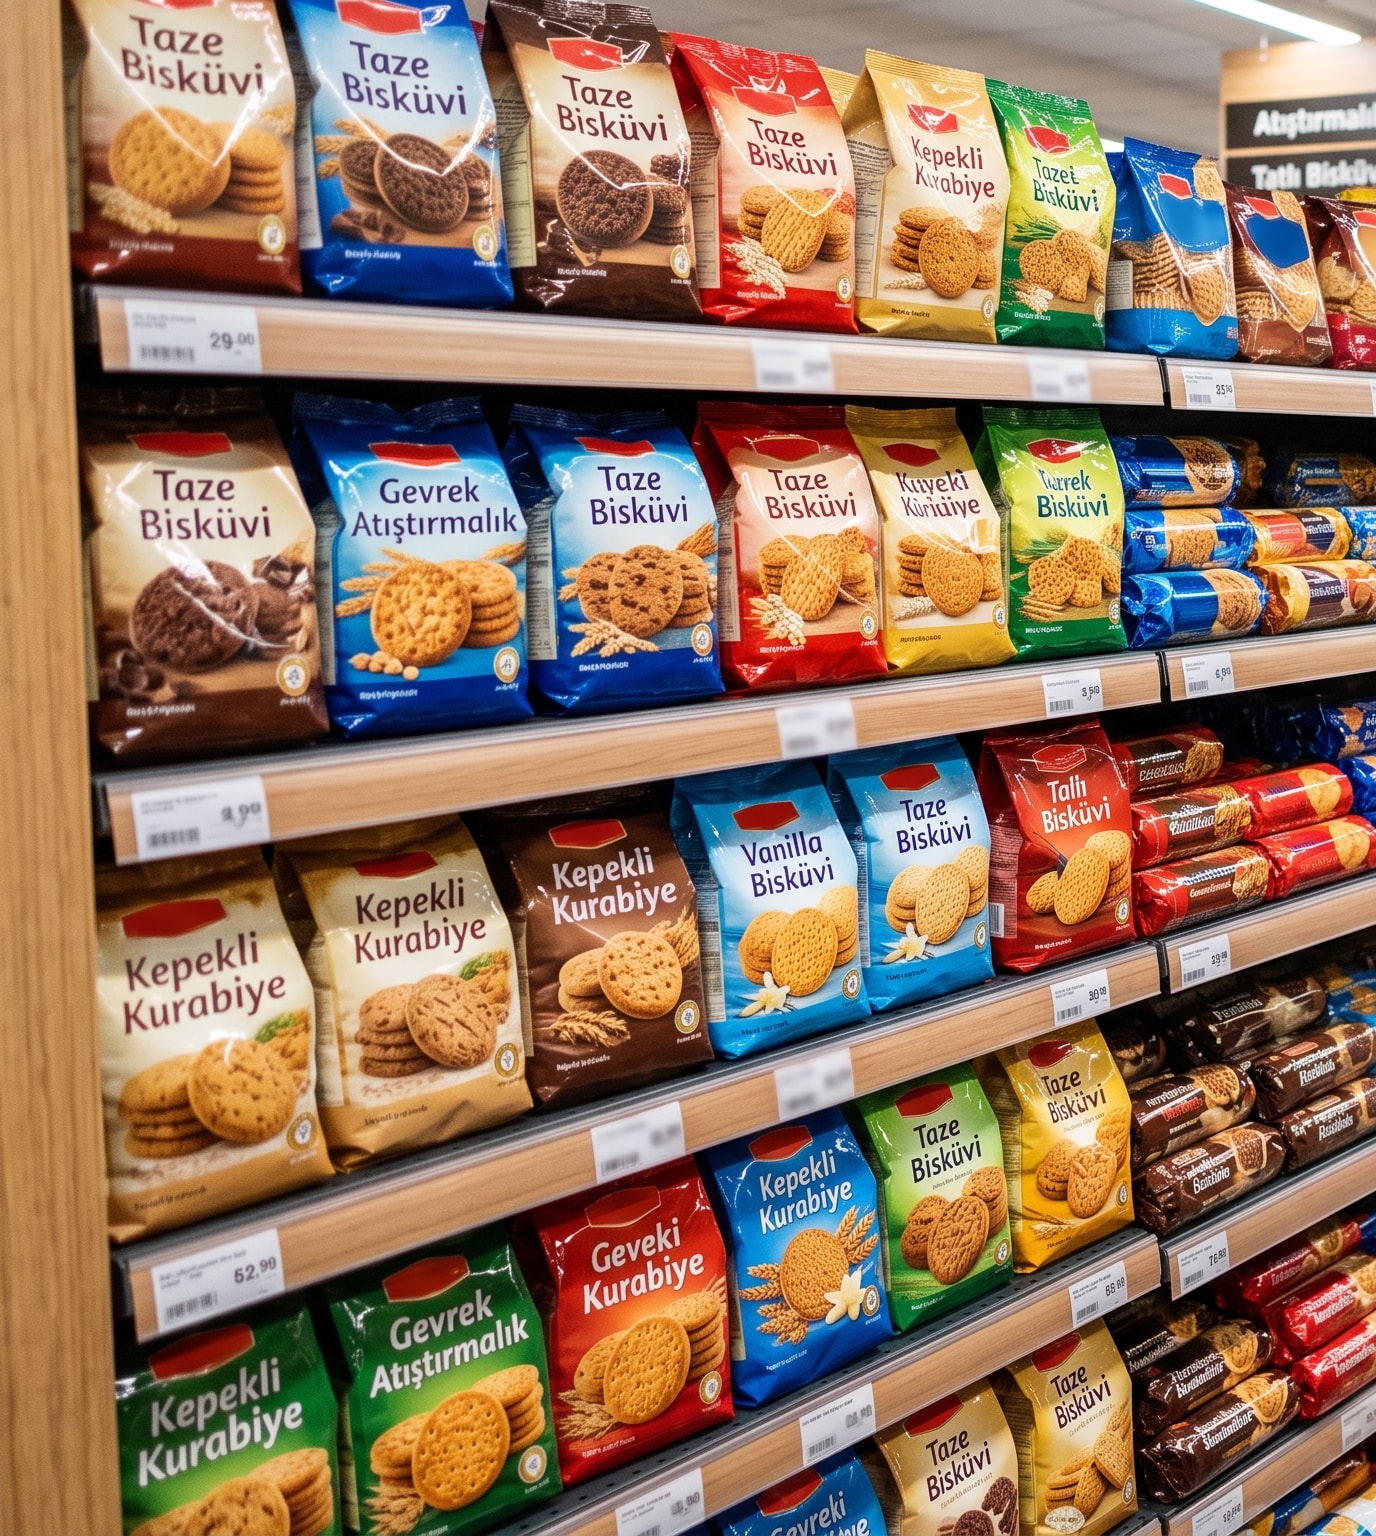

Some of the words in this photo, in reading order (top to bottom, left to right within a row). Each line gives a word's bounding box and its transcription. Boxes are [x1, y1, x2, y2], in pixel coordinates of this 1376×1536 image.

[130, 15, 224, 57] Taze
[121, 48, 263, 97] Bisküvi
[350, 41, 430, 79] Taze
[342, 72, 467, 116] Bisküvi
[562, 75, 633, 109] Taze
[557, 102, 668, 142] Bisküvi
[747, 118, 806, 148] Taze
[749, 141, 838, 177] Bisküvi
[911, 135, 983, 171] Kepekli
[1033, 178, 1099, 212] Bisküvi
[1251, 161, 1301, 190] Tatlı
[153, 470, 235, 501] Taze
[379, 476, 480, 506] Gevrek
[597, 465, 662, 493] Taze
[768, 468, 828, 490] Taze
[140, 505, 272, 541] Bisküvi
[352, 506, 518, 544] Atıştırmalık
[590, 493, 689, 527] Bisküvi
[766, 492, 857, 520] Bisküvi
[1037, 493, 1109, 518] Bisküvi
[900, 798, 947, 823] Taze
[1041, 795, 1111, 834] Bisküvi
[740, 831, 823, 867] Vanilla
[897, 818, 972, 854] Bisküvi
[552, 846, 654, 891] Kepekli
[750, 856, 834, 898] Bisküvi
[355, 877, 465, 927] Kepekli
[551, 881, 678, 925] Kurabiye
[354, 913, 487, 964] Kurabiye
[124, 931, 259, 992] Kepekli
[123, 975, 286, 1035] Kurabiye
[1041, 1069, 1082, 1097] Taze
[1048, 1083, 1107, 1124] Bisküvi
[913, 1119, 960, 1150] Taze
[759, 1149, 836, 1202] Kepekli
[911, 1134, 982, 1184] Bisküvi
[759, 1179, 853, 1235] Kurabiye
[591, 1217, 681, 1274] Geveki
[583, 1253, 705, 1315] Kurabiye
[389, 1289, 493, 1351] Gevrek
[370, 1313, 529, 1399] Atıştırmalık
[150, 1358, 281, 1438] Kepekli
[1050, 1364, 1088, 1399] Taze
[1054, 1374, 1112, 1430] Bisküvi
[138, 1401, 303, 1487] Kurabiye
[925, 1430, 970, 1466] Taze
[926, 1447, 992, 1502] Bisküvi
